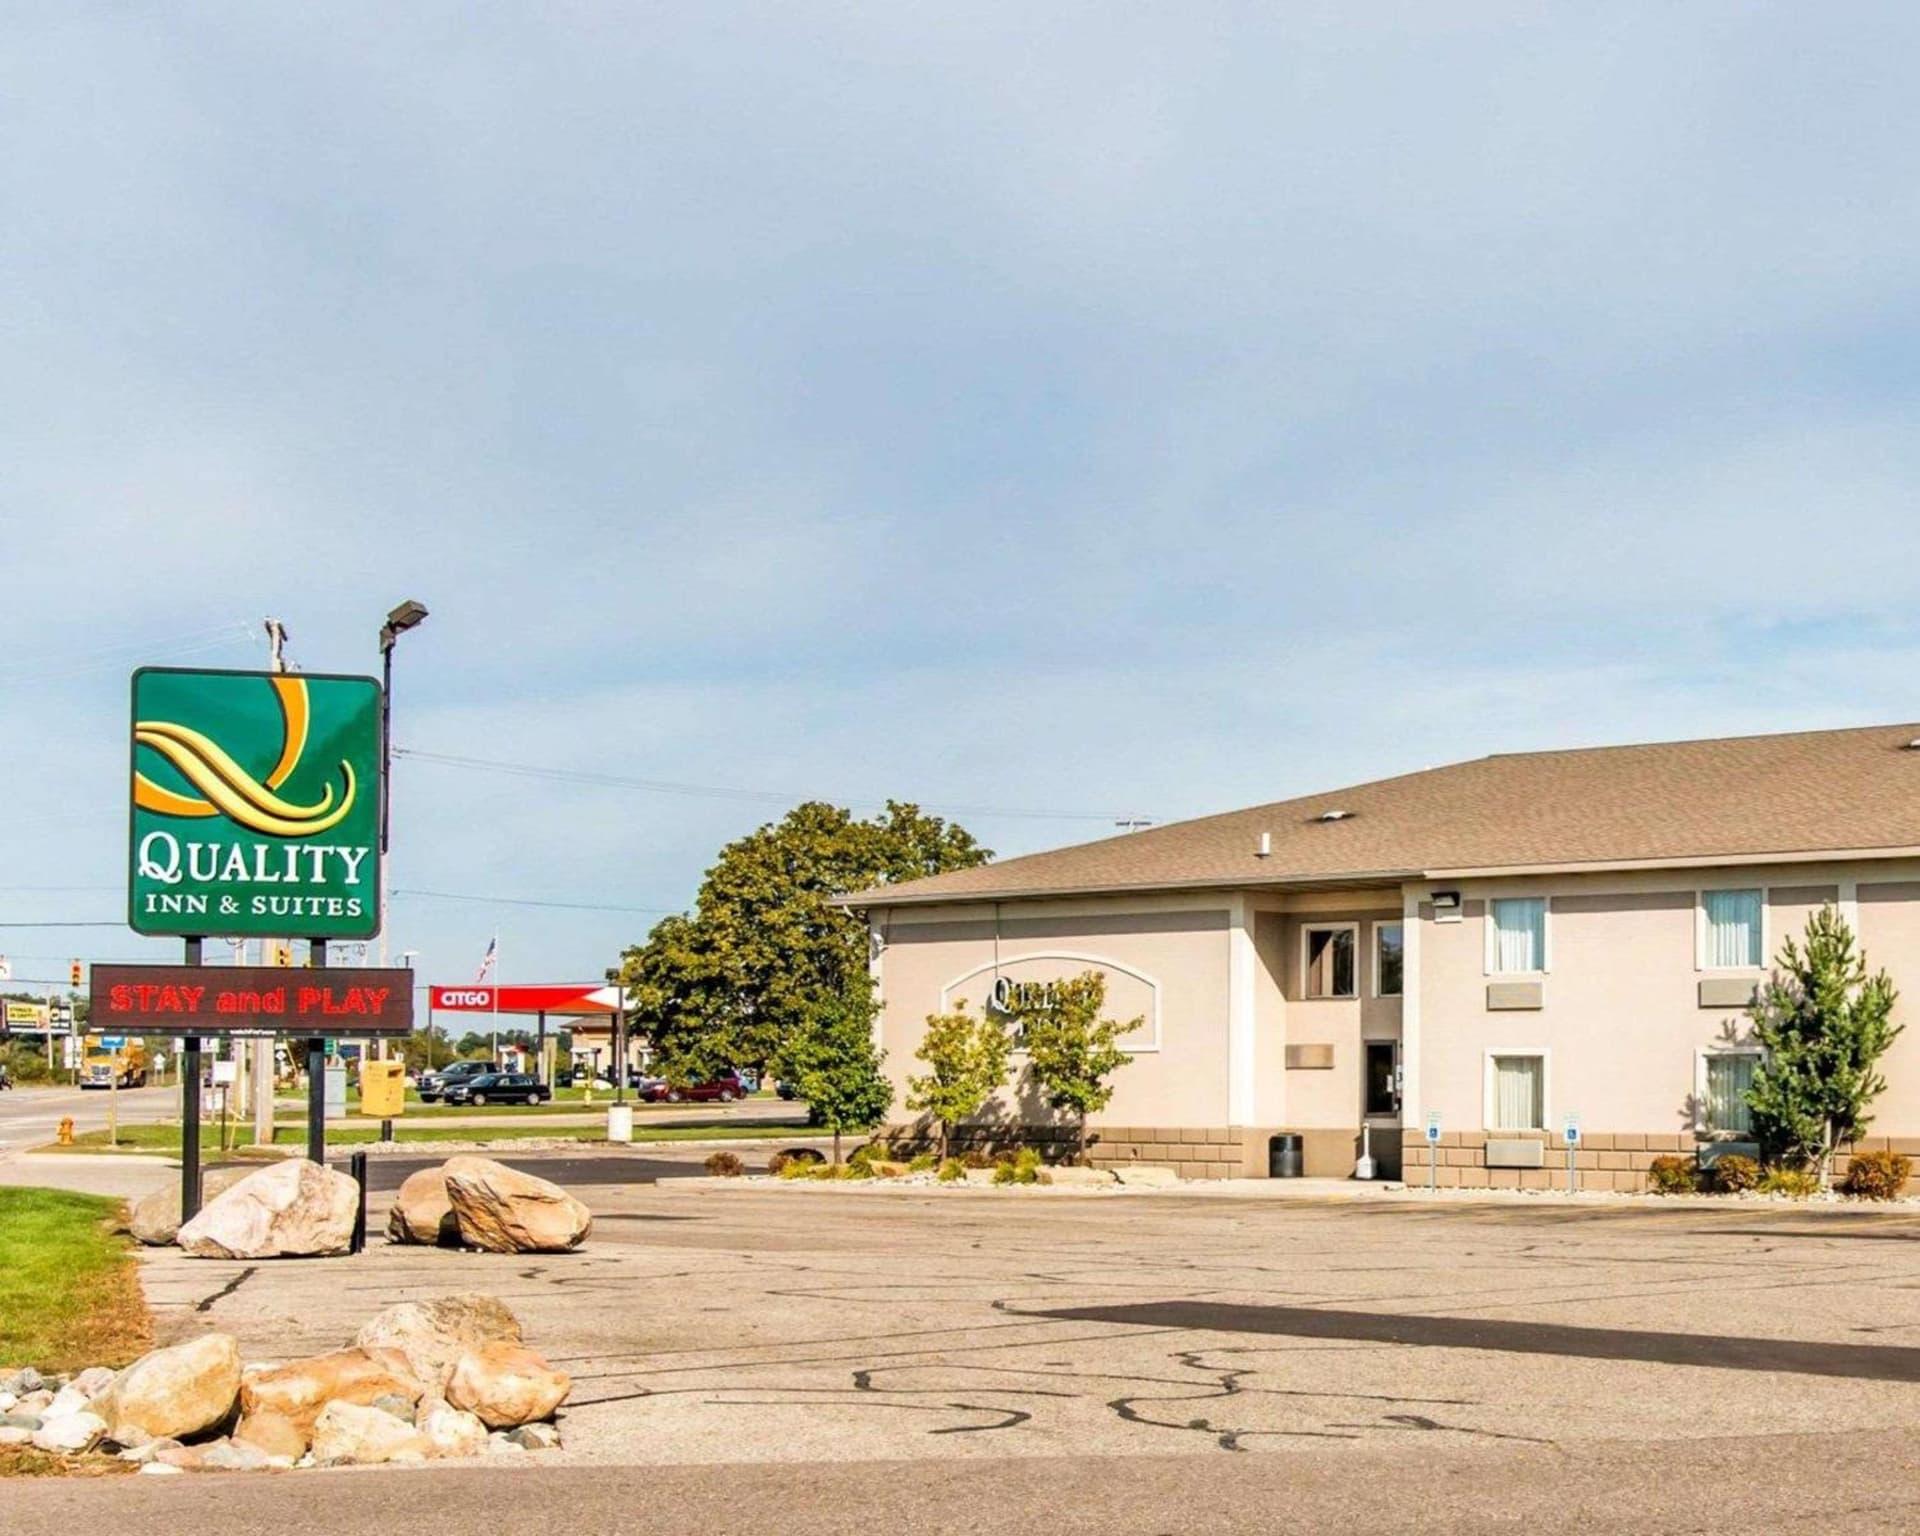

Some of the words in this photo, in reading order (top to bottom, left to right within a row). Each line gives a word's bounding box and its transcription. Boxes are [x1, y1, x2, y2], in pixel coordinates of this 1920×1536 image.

[139, 831, 368, 884] QUALITY
[145, 893, 207, 913] INN
[219, 896, 240, 914] &
[252, 896, 362, 916] SUITES
[110, 985, 205, 1012] STAY
[216, 987, 286, 1014] and
[297, 987, 389, 1014] PLAY
[441, 991, 490, 1006] CITGO
